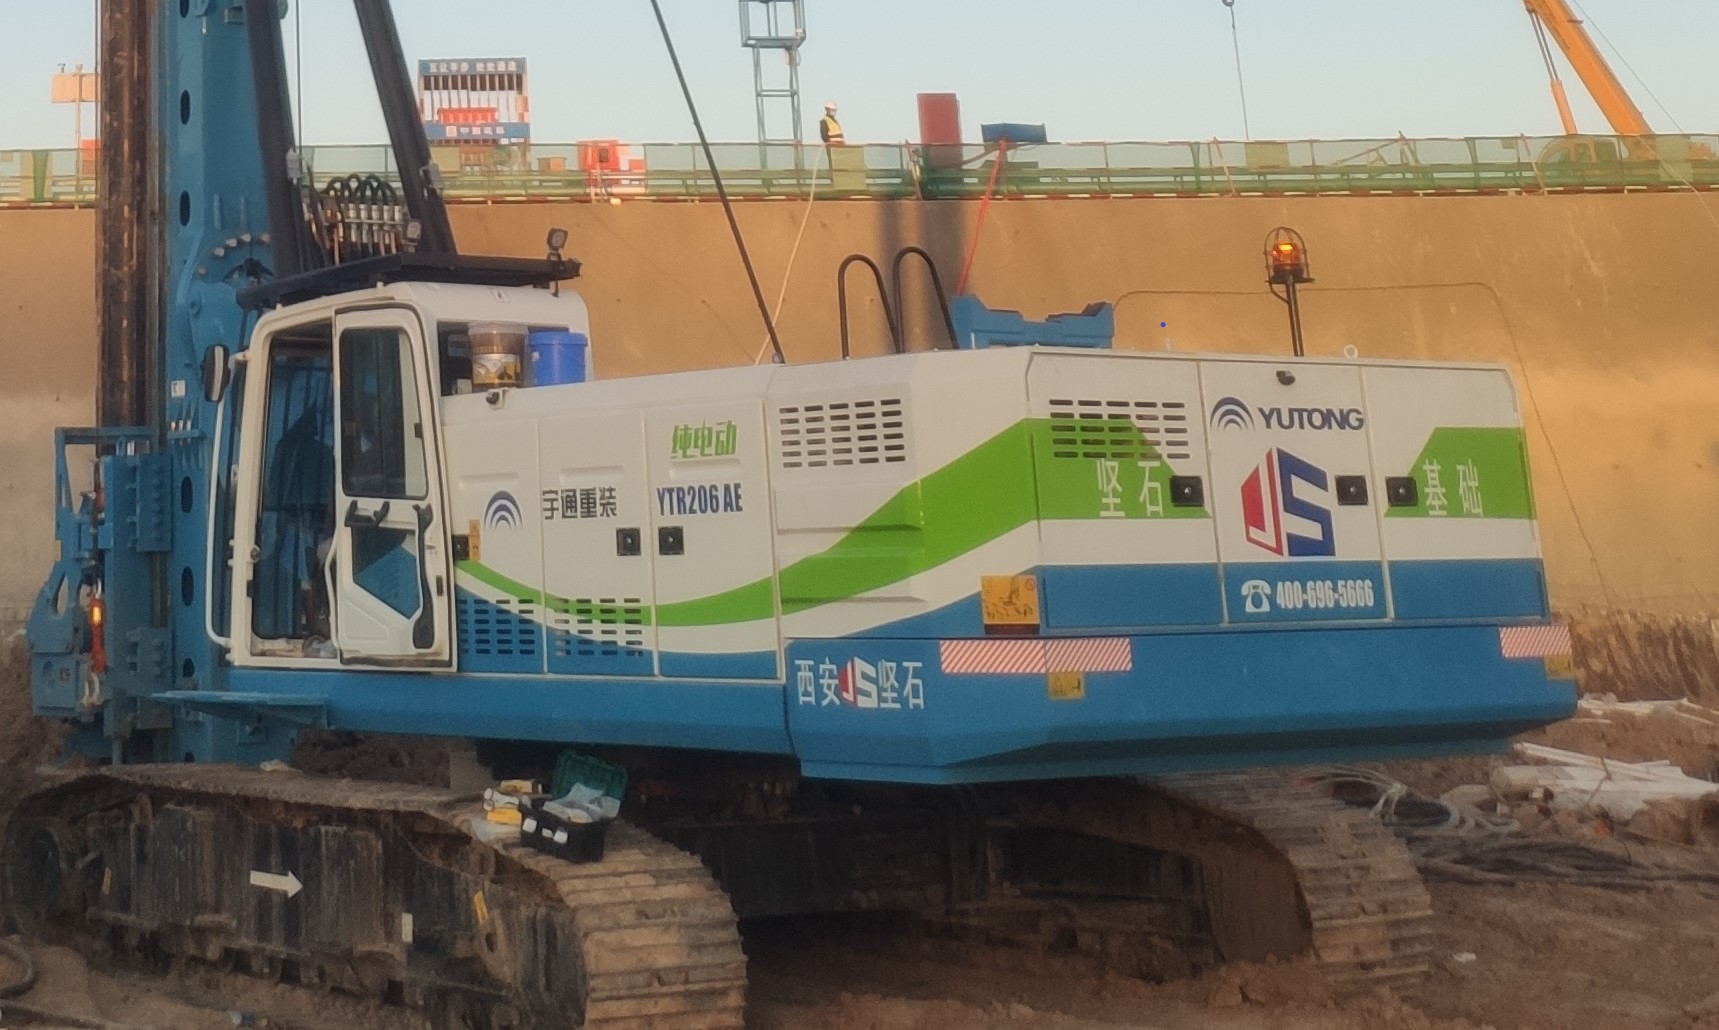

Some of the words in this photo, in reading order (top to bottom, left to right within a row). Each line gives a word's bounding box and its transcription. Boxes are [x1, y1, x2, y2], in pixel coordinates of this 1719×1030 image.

[670, 417, 738, 459] 纯电动
[1257, 407, 1365, 431] YUTONG
[542, 486, 618, 520] 宇通重装
[1096, 458, 1164, 517] 坚石
[1422, 458, 1483, 516] 基础
[1276, 579, 1375, 609] 400-696-5666
